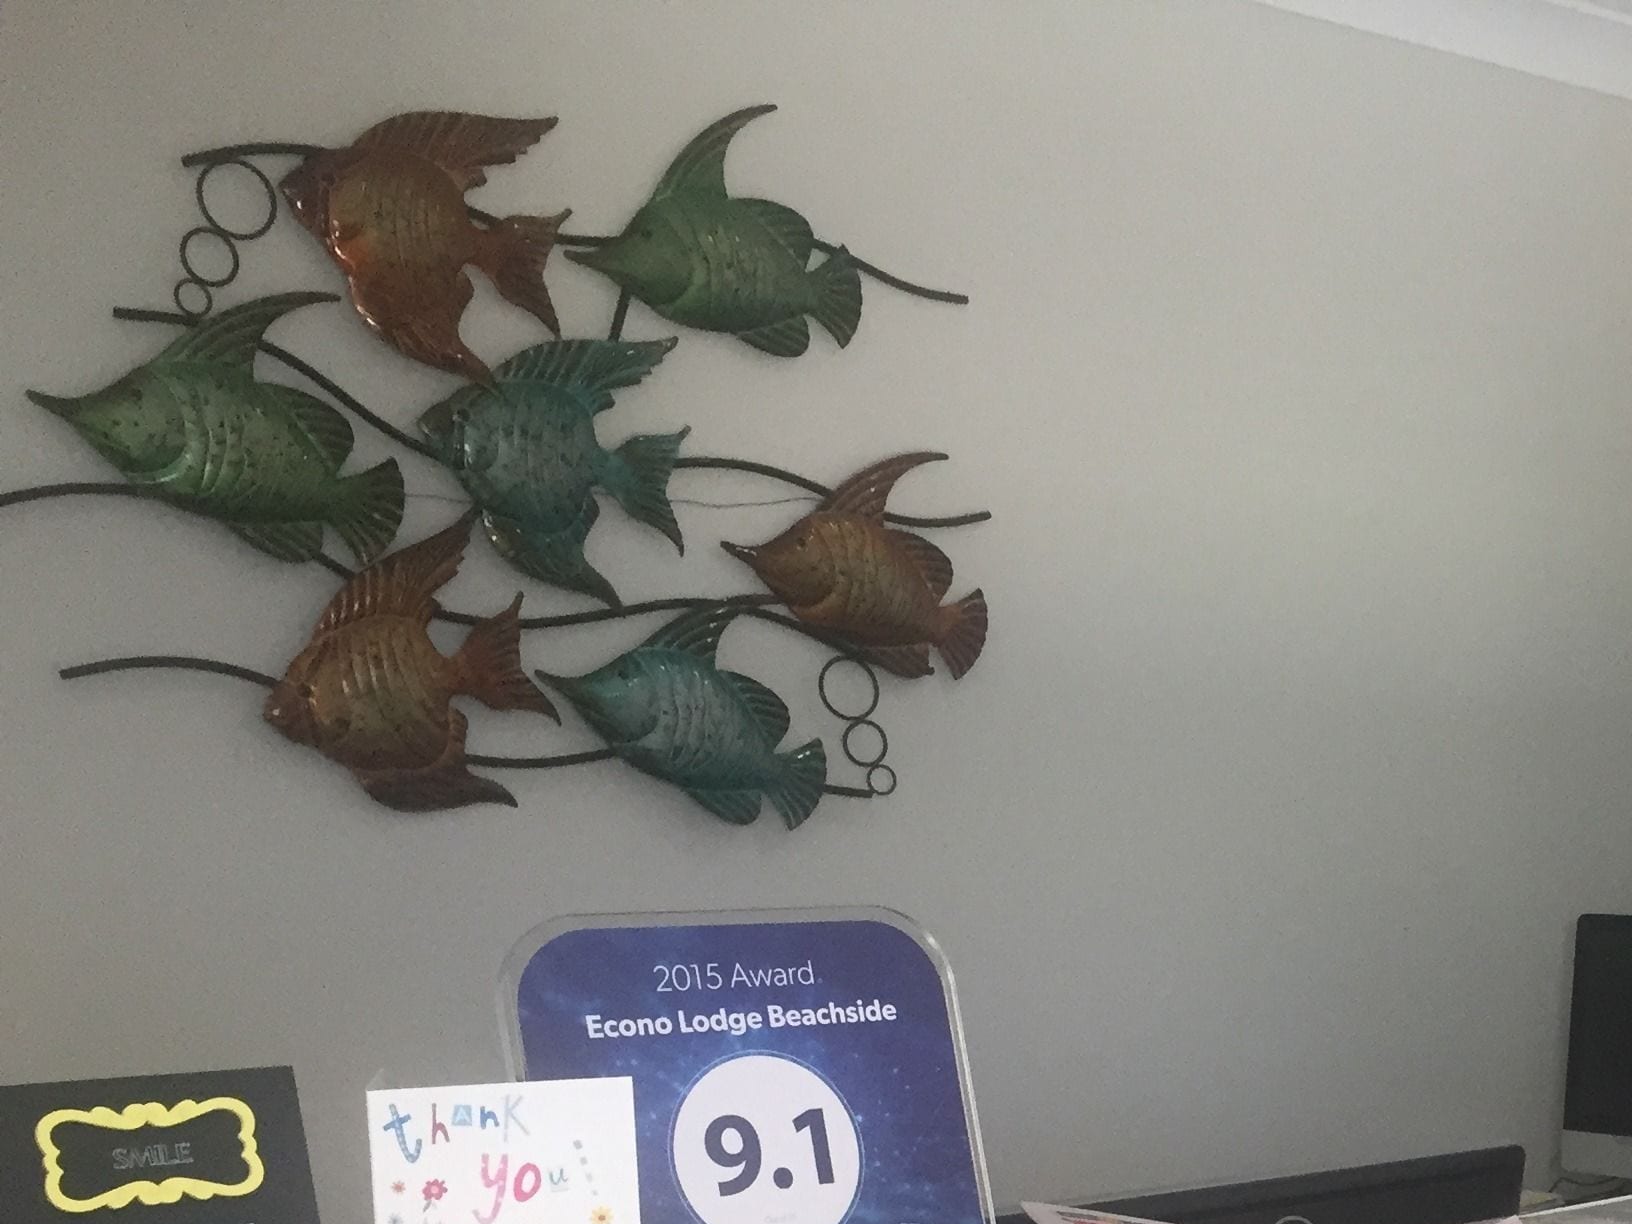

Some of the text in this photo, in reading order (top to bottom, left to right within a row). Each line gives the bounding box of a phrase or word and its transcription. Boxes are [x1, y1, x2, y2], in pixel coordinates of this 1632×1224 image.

[653, 960, 816, 992] 2015 Award
[585, 999, 898, 1039] Econo Lodge Beachside
[112, 1142, 194, 1169] SMILE
[703, 1107, 836, 1198] 9.1
